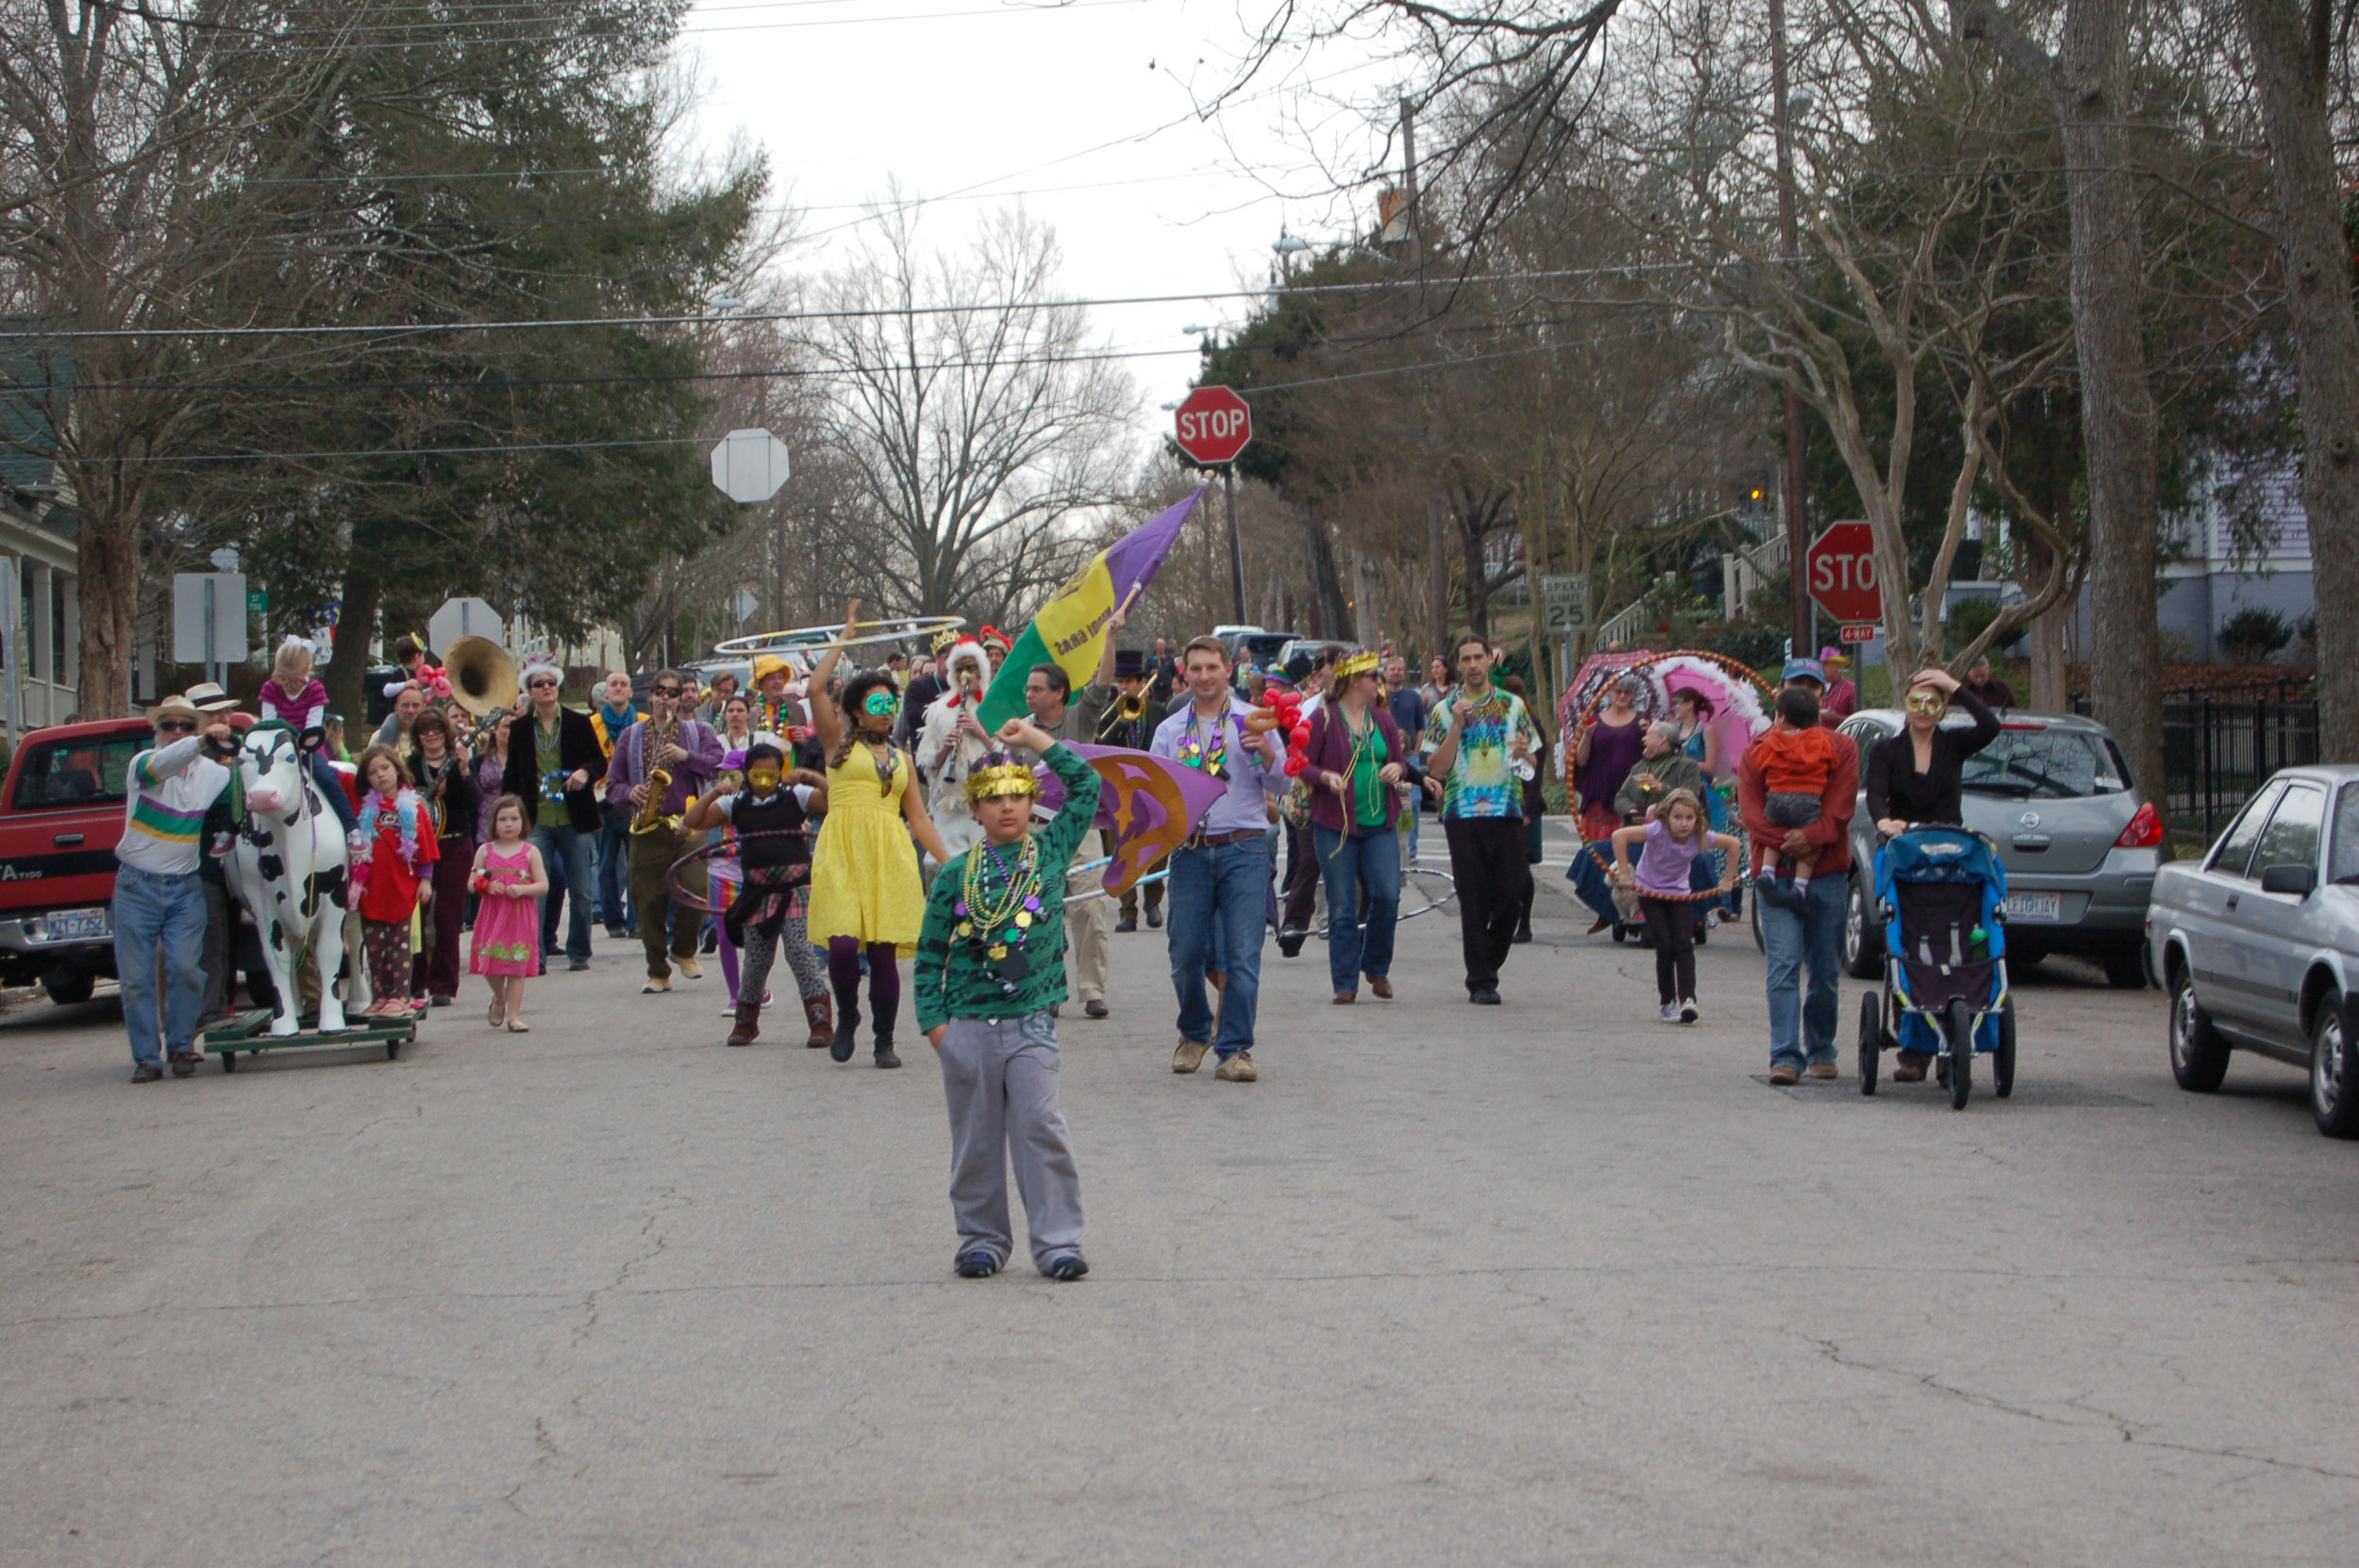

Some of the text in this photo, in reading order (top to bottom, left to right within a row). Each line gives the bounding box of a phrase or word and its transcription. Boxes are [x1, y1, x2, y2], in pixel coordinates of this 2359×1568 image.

[1180, 409, 1245, 441] STOP
[1815, 553, 1877, 591] STO
[1546, 580, 1585, 592] SPEED
[1550, 593, 1580, 604] LIMIT
[1549, 605, 1584, 626] 25
[1845, 627, 1871, 641] 4-WAY
